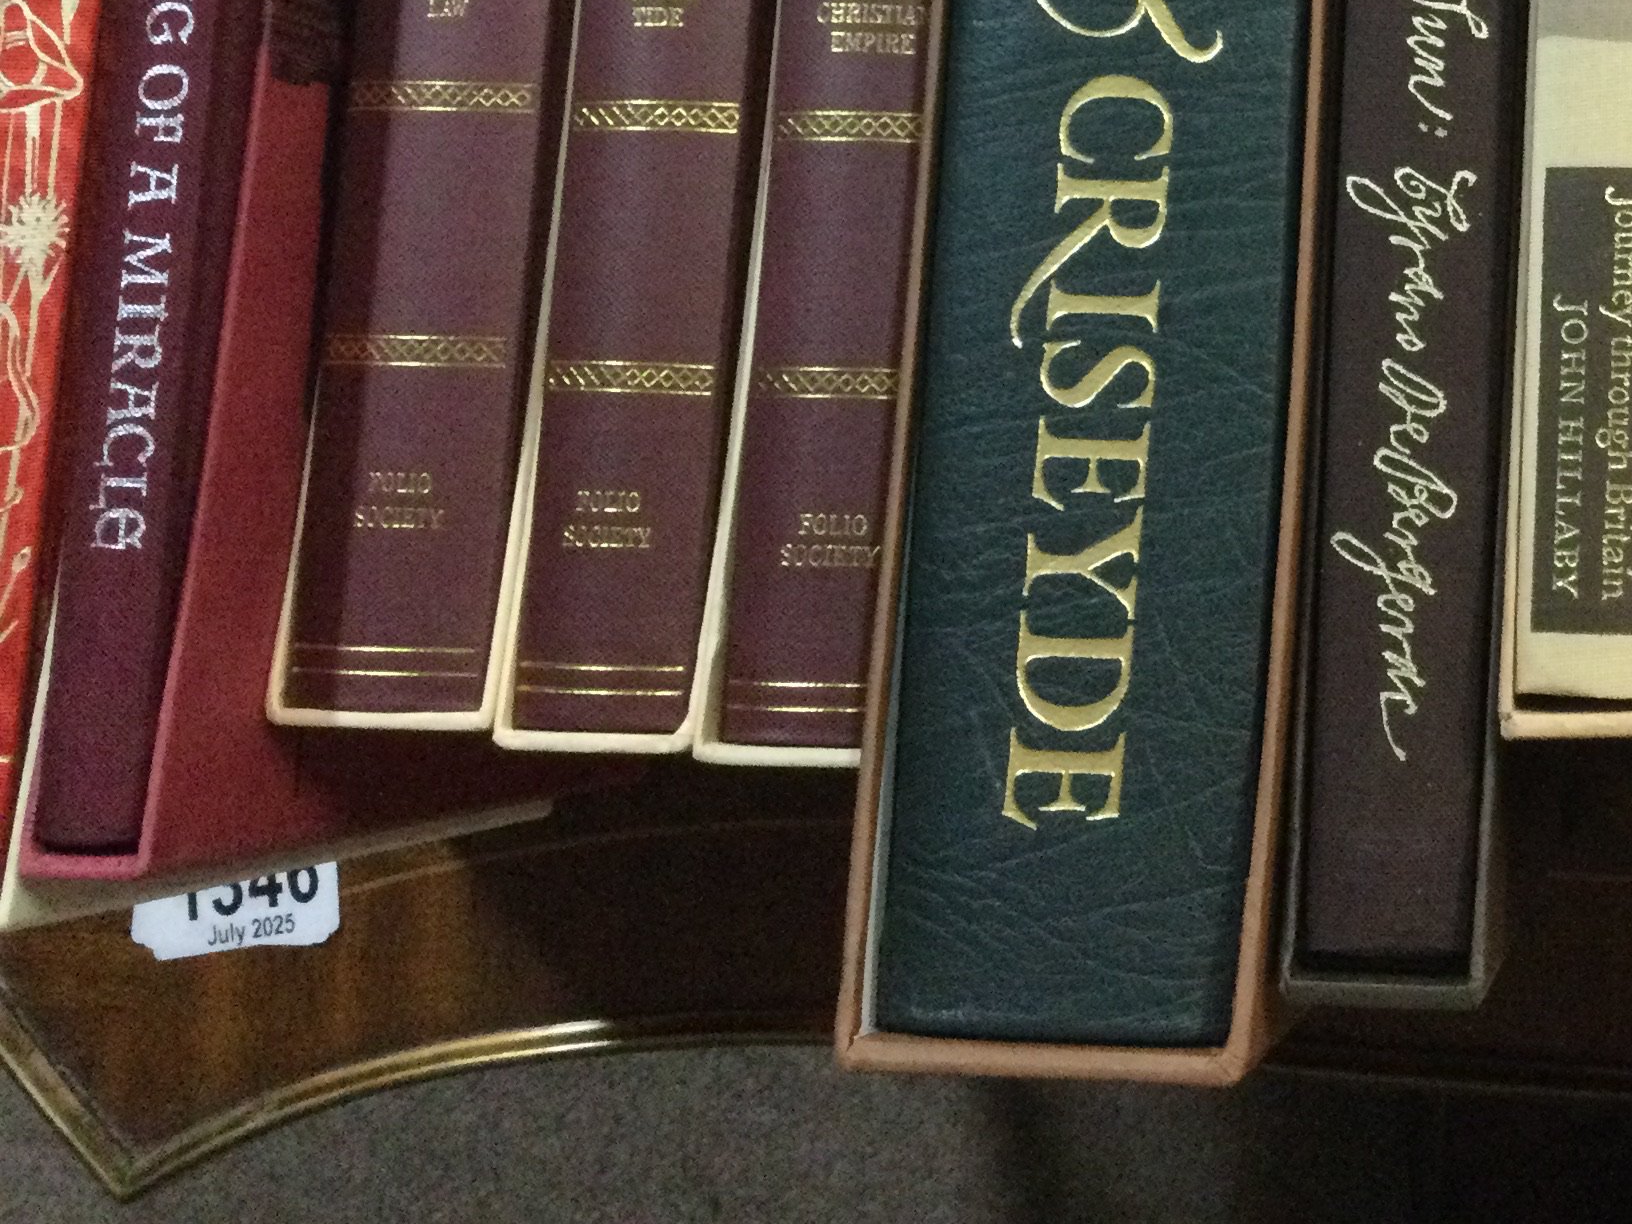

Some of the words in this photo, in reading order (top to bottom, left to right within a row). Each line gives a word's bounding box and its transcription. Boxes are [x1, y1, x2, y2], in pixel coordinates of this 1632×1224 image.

[830, 31, 916, 55] EMPIRE
[134, 64, 190, 143] OF
[127, 161, 180, 212] A
[1553, 292, 1589, 405] JOHN
[1000, 73, 1175, 832] CRISEYDE
[798, 513, 869, 536] FOLIO
[1551, 415, 1585, 601] HILLABY
[780, 543, 881, 568] SOCIETY
[207, 923, 246, 947] July
[252, 913, 296, 938] 2025
